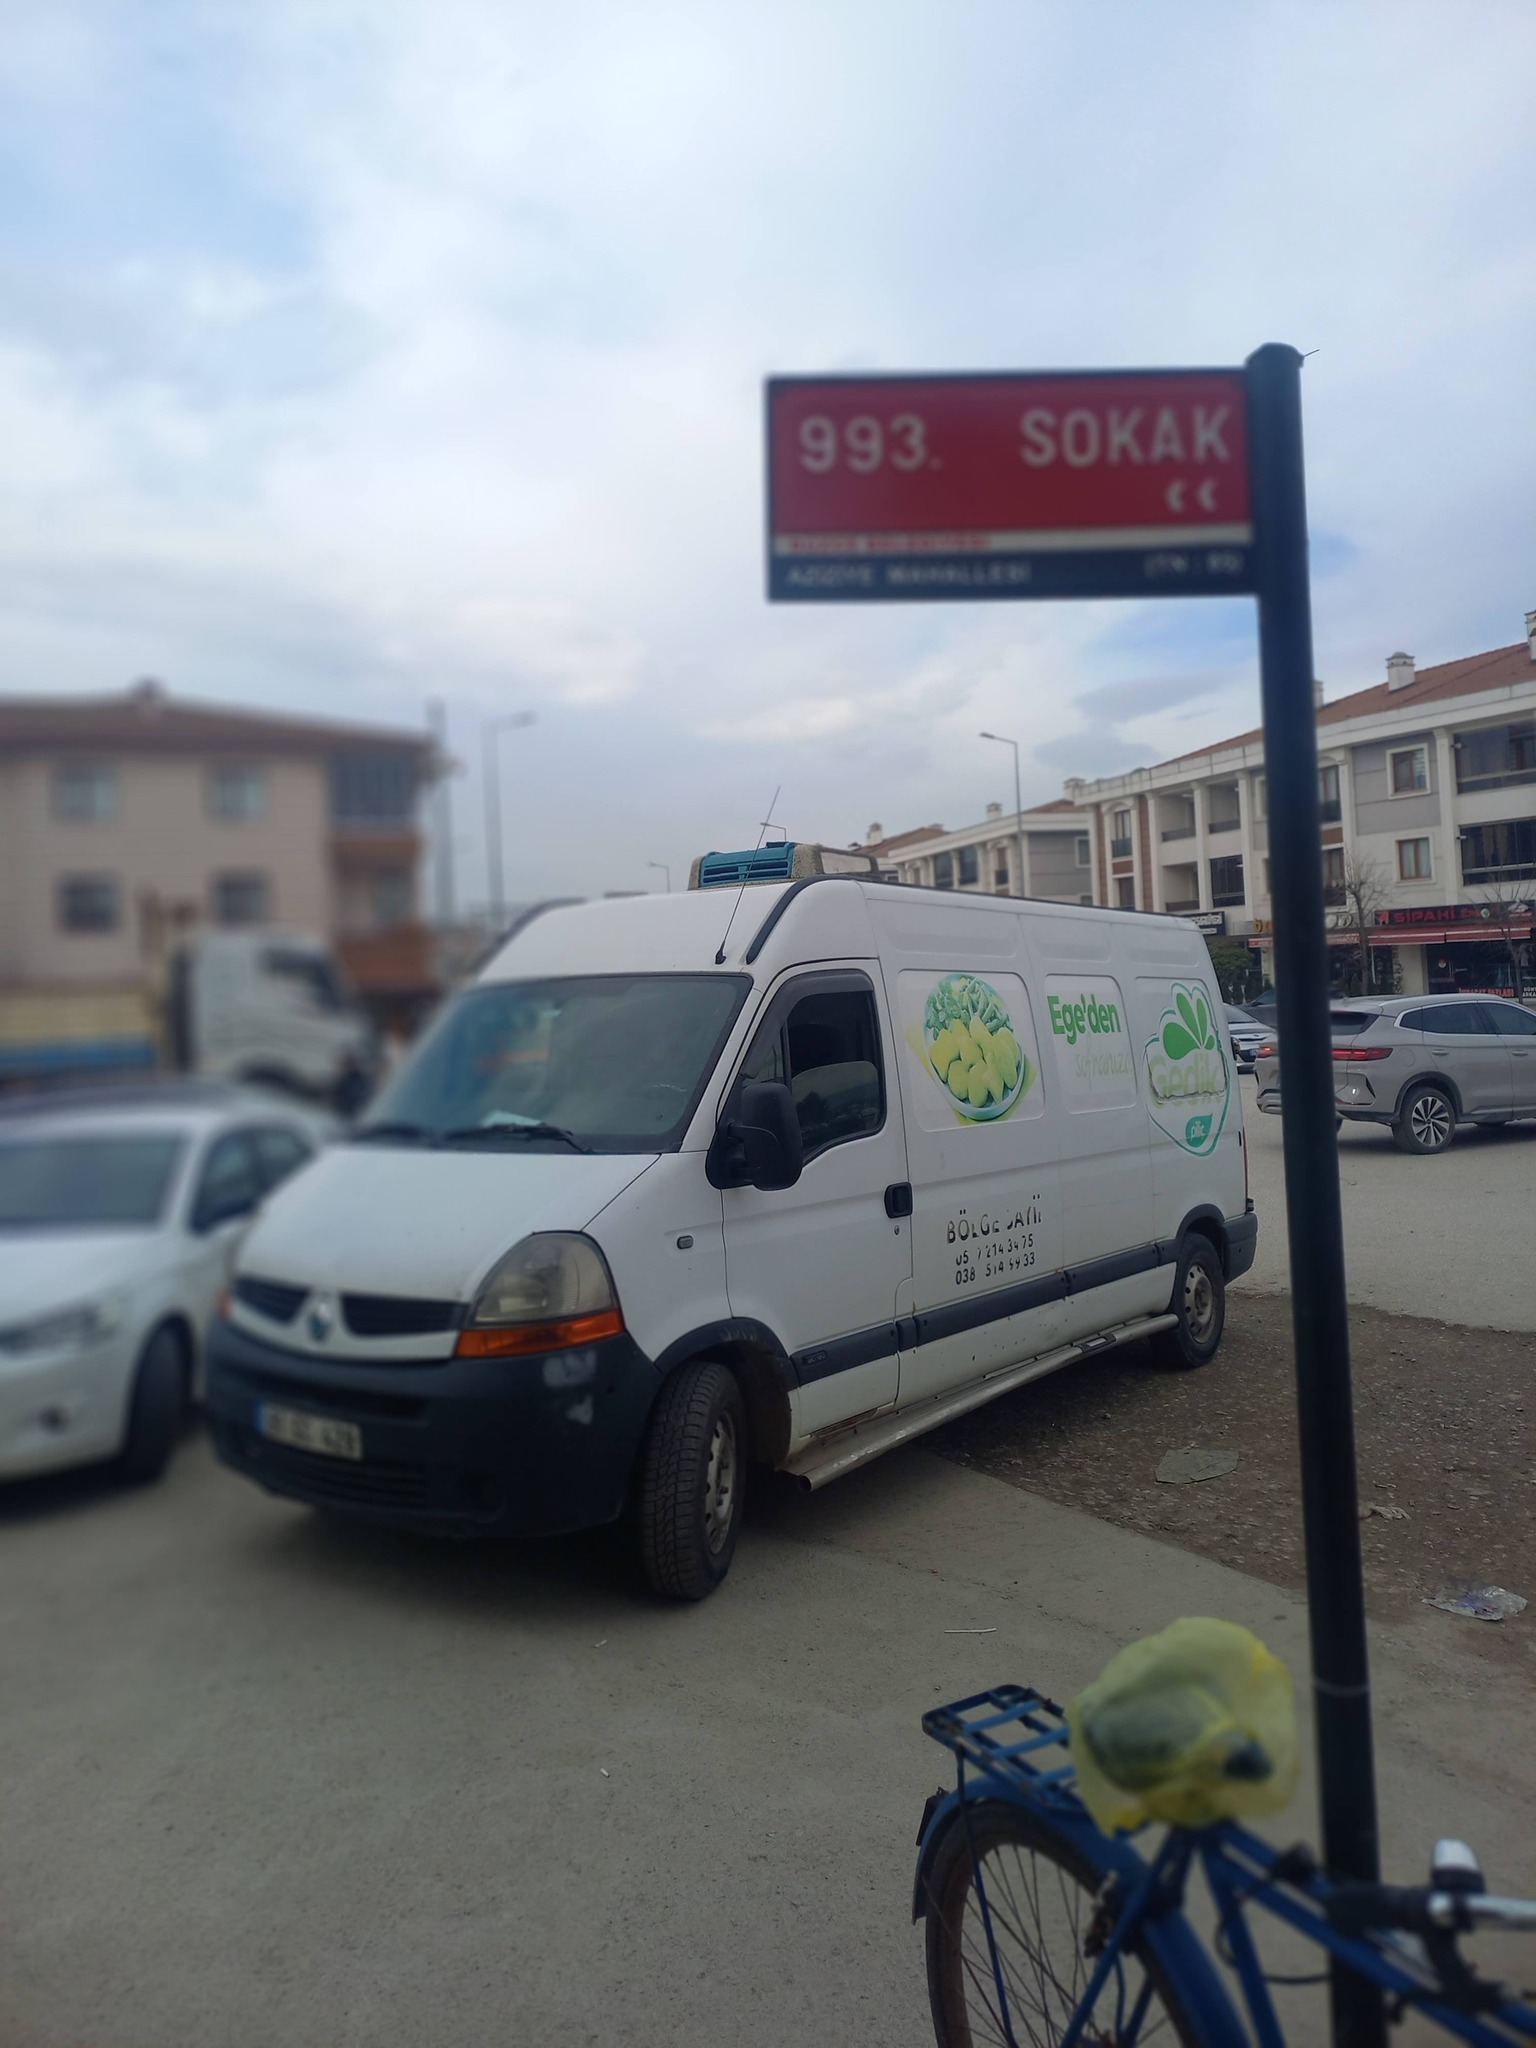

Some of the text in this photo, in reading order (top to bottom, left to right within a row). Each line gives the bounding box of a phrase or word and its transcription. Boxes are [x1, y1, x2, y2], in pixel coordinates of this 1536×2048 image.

[1020, 406, 1231, 468] SOKAK
[1047, 994, 1121, 1045] Ege'den
[1149, 1054, 1221, 1109] Gedik
